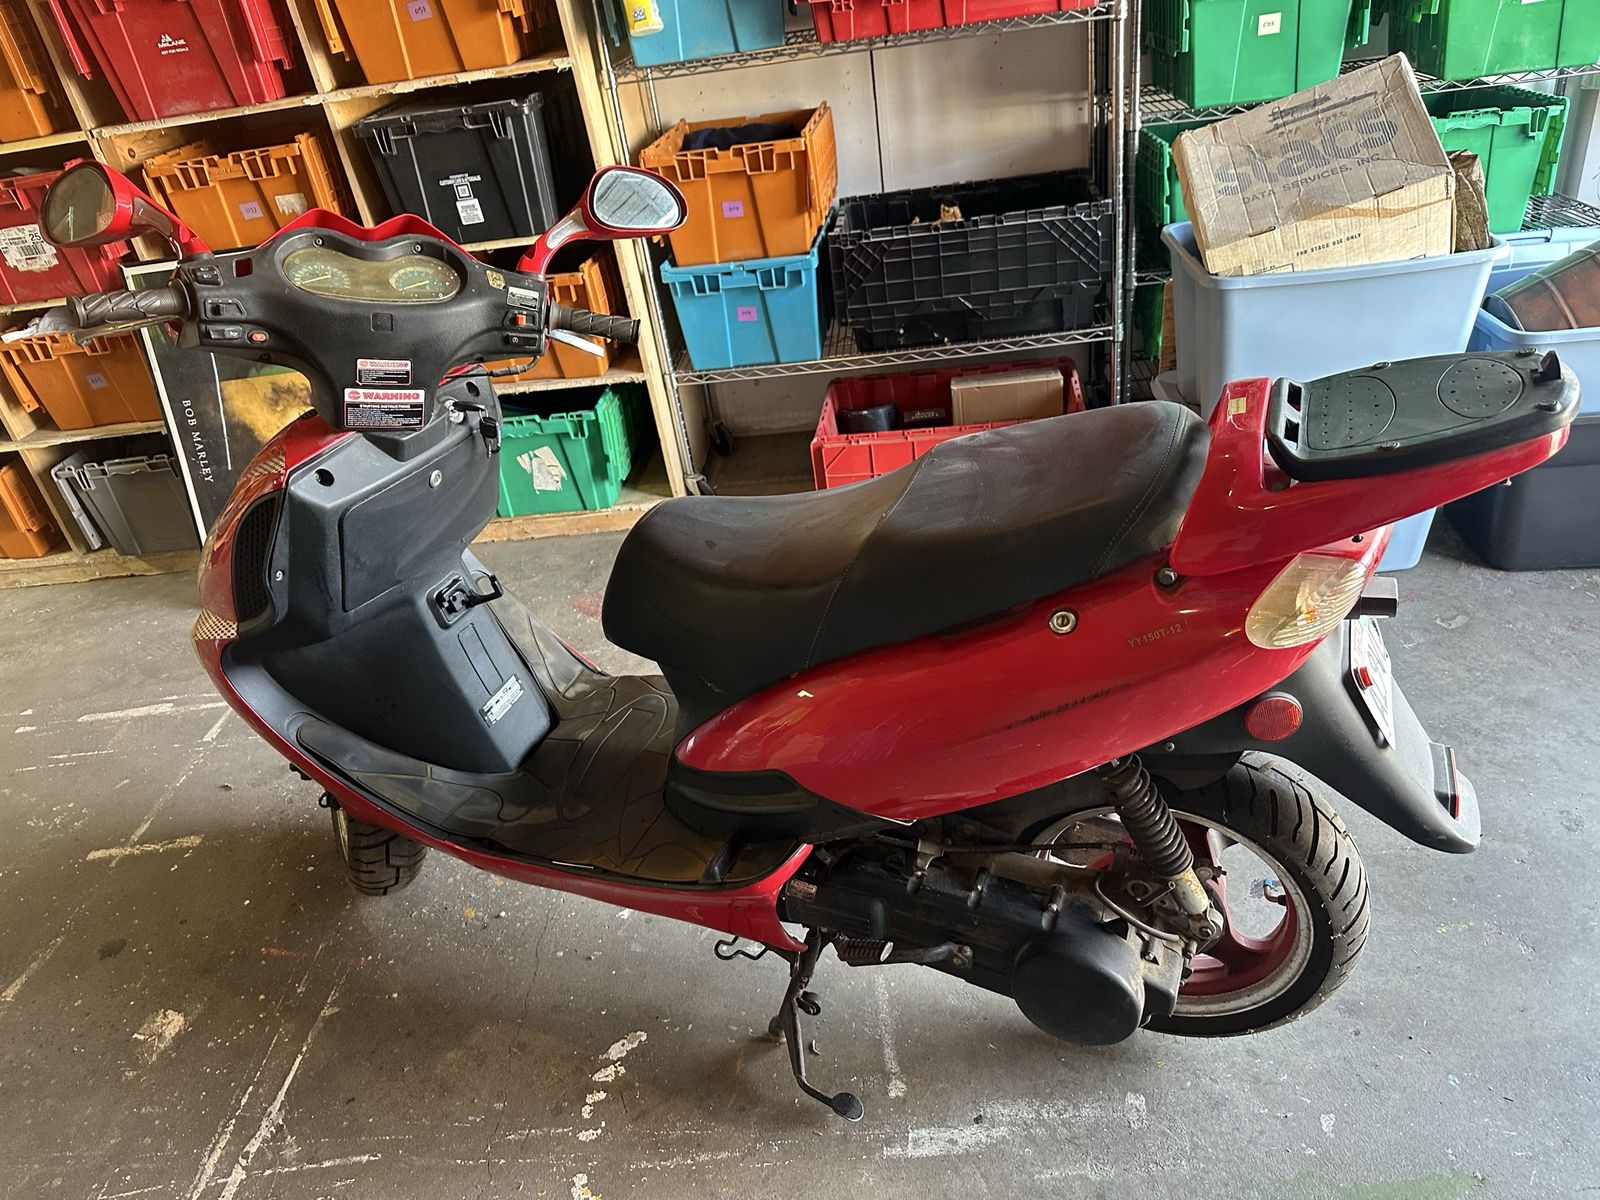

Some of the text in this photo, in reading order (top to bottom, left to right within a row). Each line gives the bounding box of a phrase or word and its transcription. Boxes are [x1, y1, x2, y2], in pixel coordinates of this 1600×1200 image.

[1243, 189, 1276, 204] DATA
[29, 233, 42, 241] 25
[1296, 232, 1361, 257] FOR STACS USE ONLY
[363, 392, 420, 400] WARNING
[182, 399, 214, 483] BOB MARLEY
[1127, 623, 1182, 648] YY150T-12
